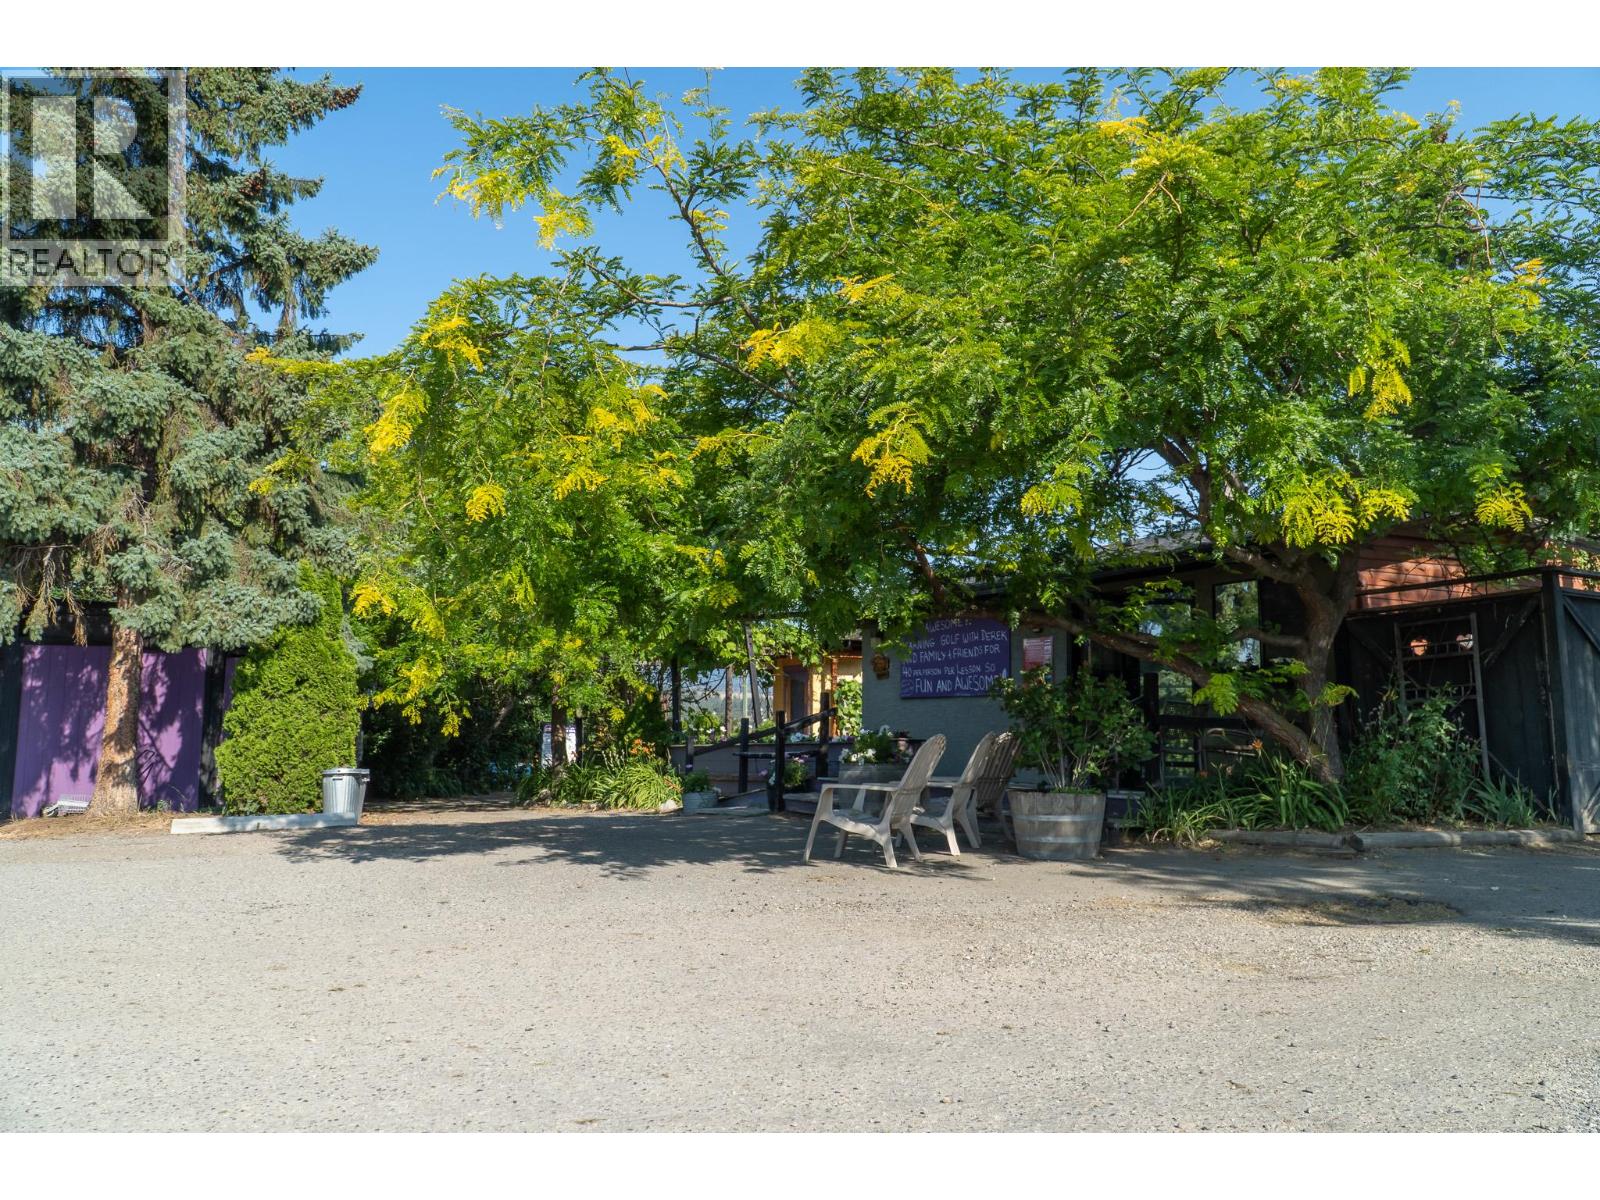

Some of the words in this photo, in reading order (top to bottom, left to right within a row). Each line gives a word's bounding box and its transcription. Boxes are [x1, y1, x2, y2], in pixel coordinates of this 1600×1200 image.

[940, 633, 961, 646] GOLF
[962, 631, 979, 644] WITH
[980, 629, 1008, 642] DEREK
[919, 650, 946, 664] FAMILY
[952, 646, 983, 659] FRIENDS
[984, 644, 1001, 655] FOR
[915, 678, 933, 694] FUN
[936, 679, 953, 693] AND
